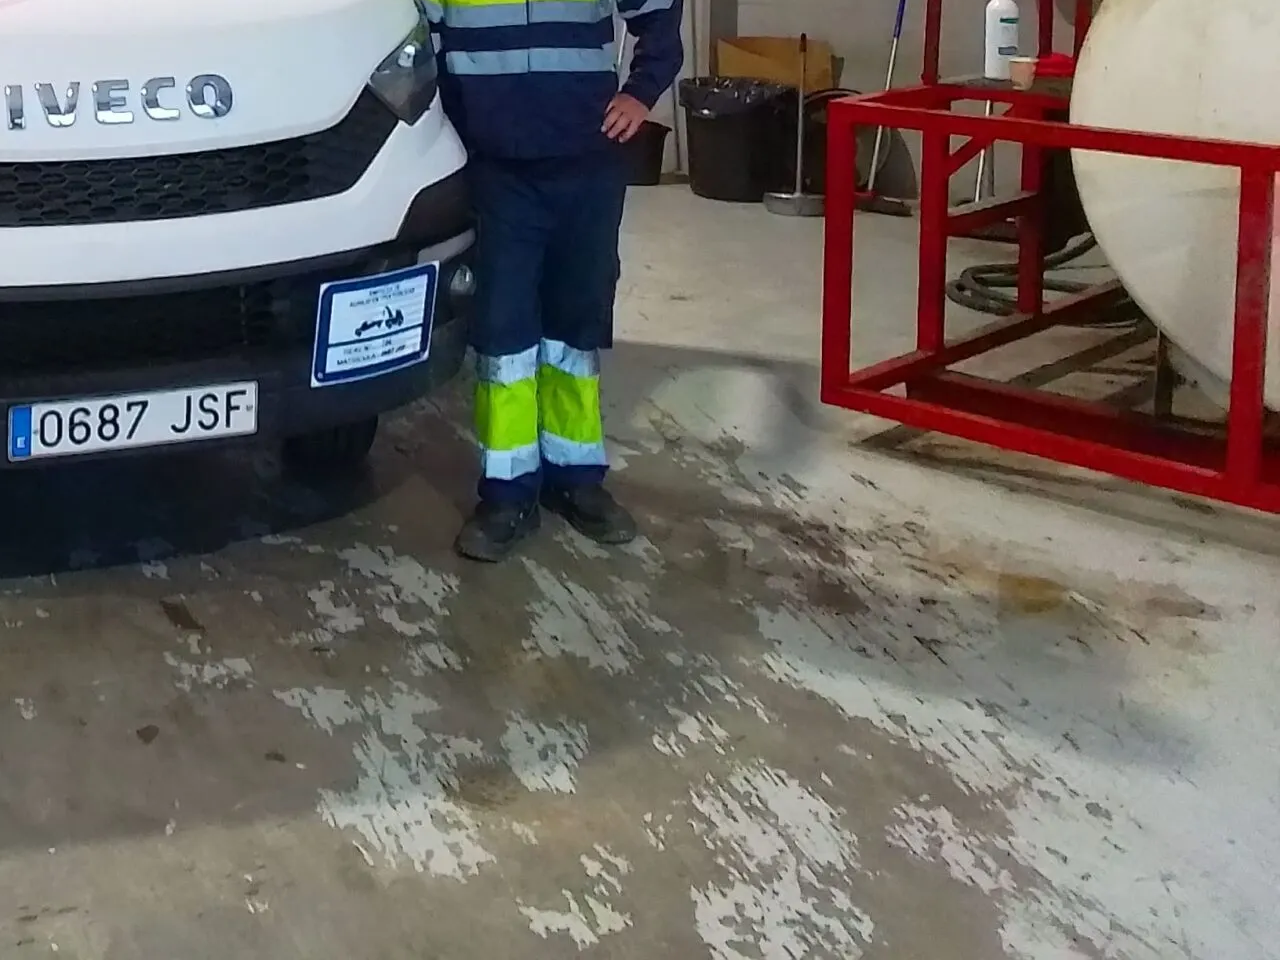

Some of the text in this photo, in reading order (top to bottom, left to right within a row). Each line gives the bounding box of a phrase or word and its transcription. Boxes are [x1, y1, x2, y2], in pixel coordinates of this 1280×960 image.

[4, 73, 233, 130] IVECO
[39, 400, 149, 448] 0687
[170, 389, 248, 434] JSF
